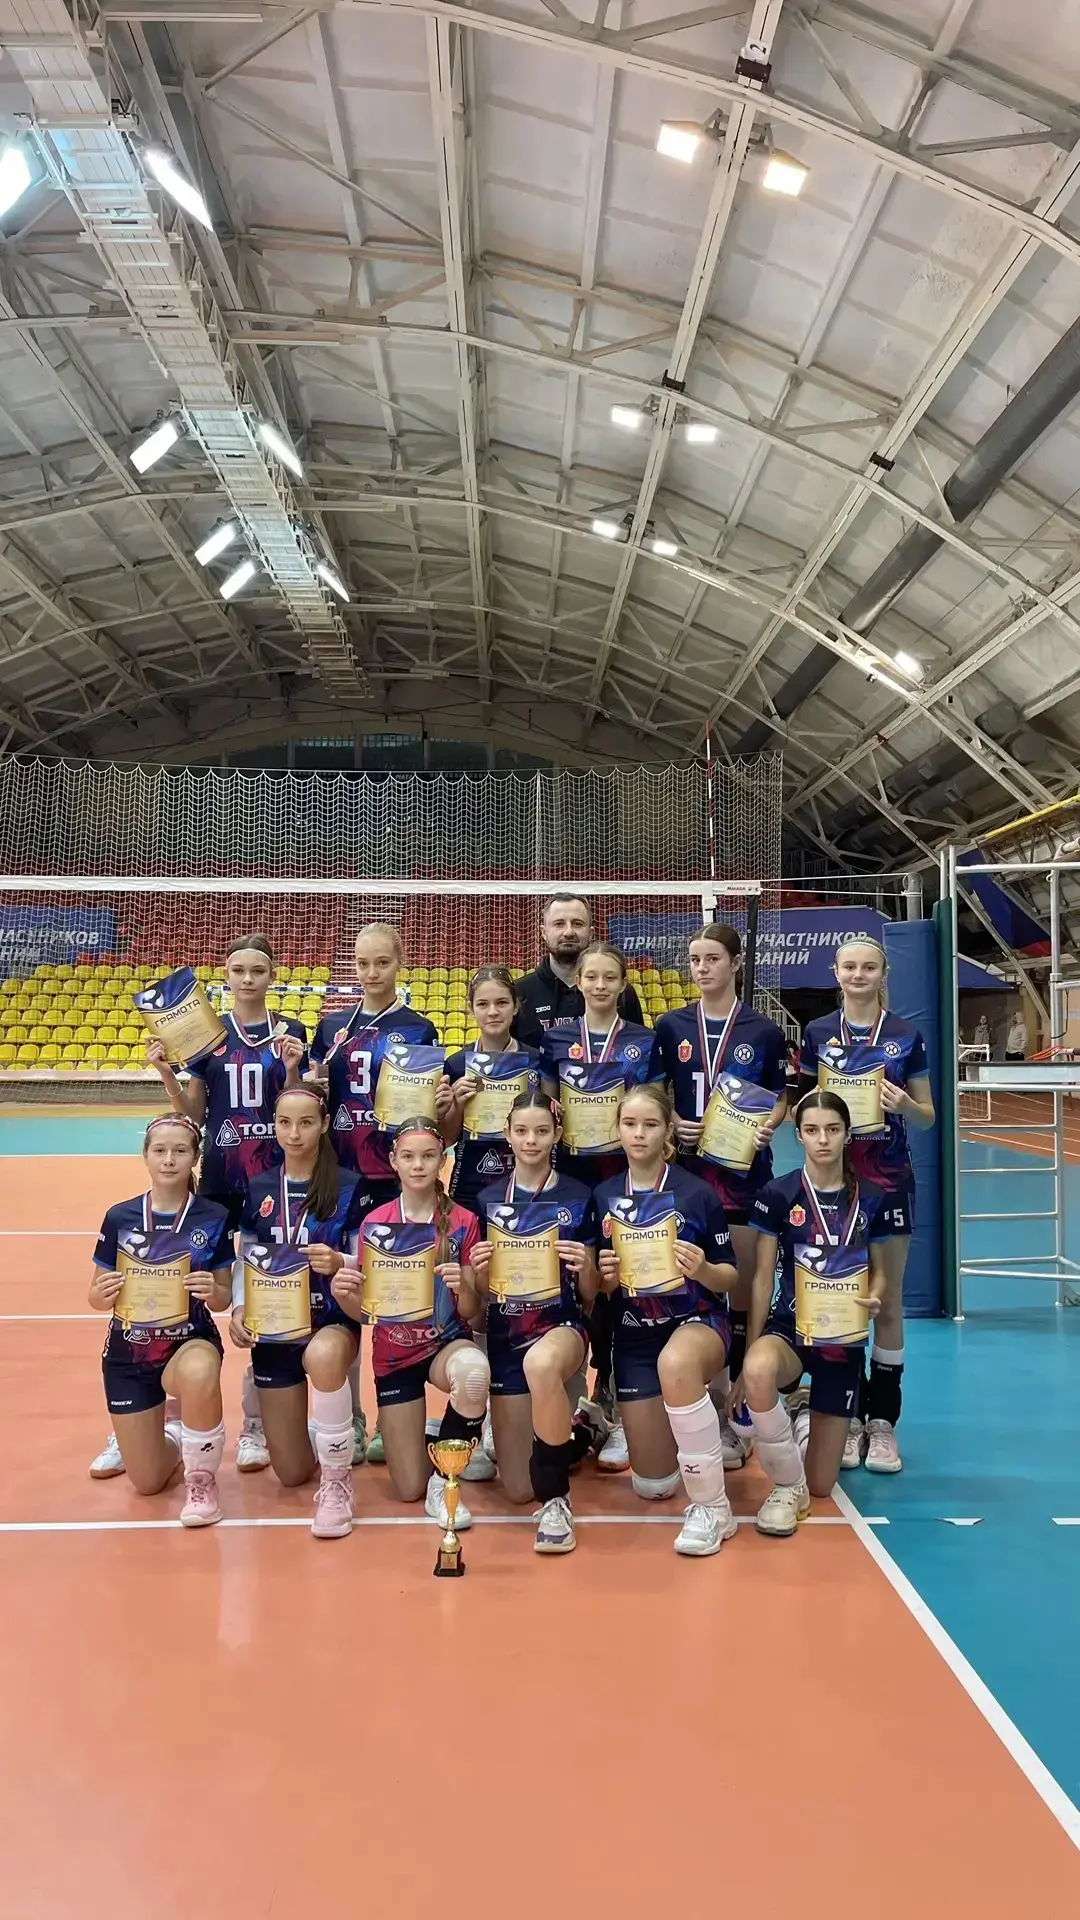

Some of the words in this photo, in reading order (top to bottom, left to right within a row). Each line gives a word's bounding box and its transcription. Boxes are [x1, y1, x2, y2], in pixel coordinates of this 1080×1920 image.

[155, 998, 201, 1028] ГРАМОТА
[350, 1051, 372, 1094] 3
[386, 1074, 434, 1086] ГРАМОТА
[826, 1077, 877, 1087] ГРАМОТА
[224, 1063, 263, 1109] 10
[485, 1083, 521, 1091] АМОТА
[568, 1095, 618, 1104] ГРАМОТА
[352, 1110, 374, 1121] ТО
[714, 1104, 759, 1129] ГРАМОТА
[893, 1208, 905, 1227] 5
[620, 1229, 669, 1241] ГРАМОТА
[497, 1240, 551, 1249] ГРАМОТА
[372, 1260, 426, 1269] ГРАМОТА
[125, 1267, 181, 1277] ГРАМОТА
[252, 1279, 302, 1289] ГРАМОТА
[804, 1281, 860, 1291] ГРАМОТА
[846, 1390, 854, 1409] 7
